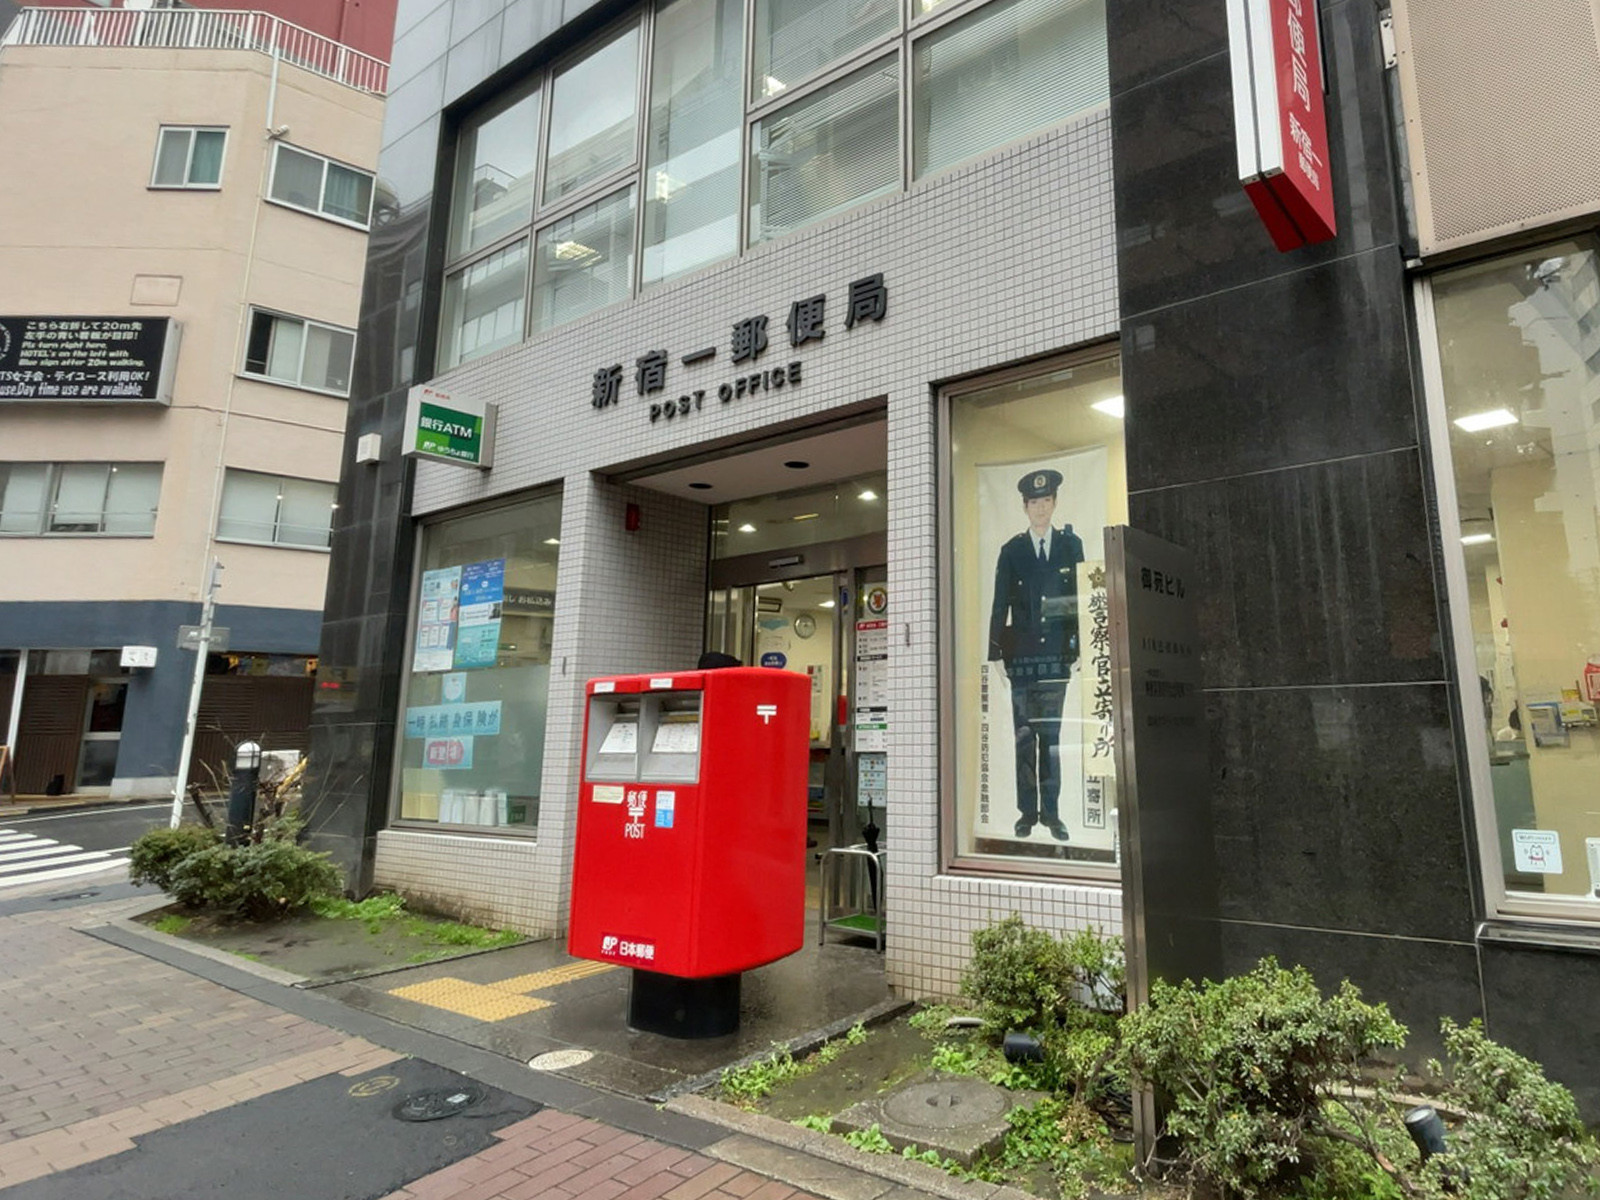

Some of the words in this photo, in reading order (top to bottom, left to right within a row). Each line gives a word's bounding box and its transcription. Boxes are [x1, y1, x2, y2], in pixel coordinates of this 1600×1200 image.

[60, 342, 83, 350] right
[592, 272, 888, 408] 新宿一郵便局
[40, 358, 59, 367] sign
[60, 358, 85, 366] after
[38, 382, 60, 395] time
[61, 385, 79, 395] use
[80, 385, 98, 395] are
[100, 382, 143, 397] available.
[650, 390, 706, 422] POST
[717, 361, 802, 401] OFFICE
[420, 416, 473, 439] 銀行ATM
[627, 790, 648, 809] 郵便
[624, 823, 646, 839] POST
[619, 941, 655, 960] 日本郵便
